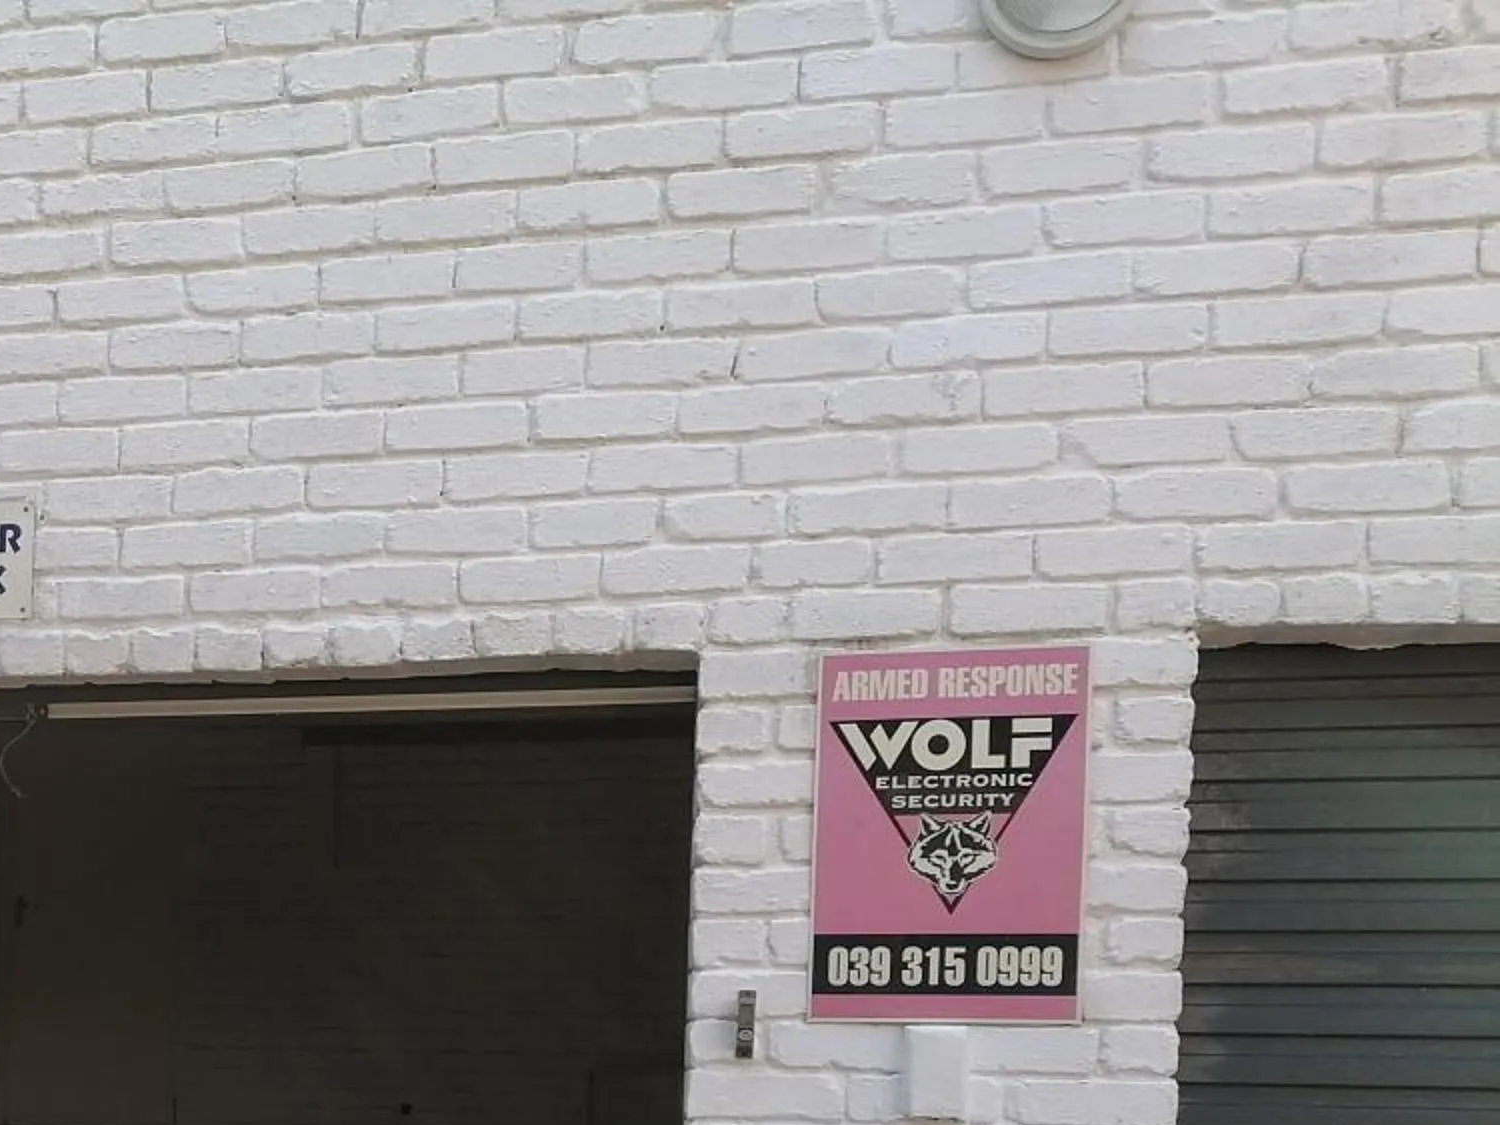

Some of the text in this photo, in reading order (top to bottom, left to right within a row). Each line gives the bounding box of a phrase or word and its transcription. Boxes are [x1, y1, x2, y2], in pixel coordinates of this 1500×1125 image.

[832, 663, 1079, 702] ARMED RESPONSE
[838, 717, 1053, 771] WOLF
[875, 773, 1034, 790] ELECTRONIC
[891, 793, 1015, 809] SECURITY
[827, 945, 1063, 987] 039 315 0999
